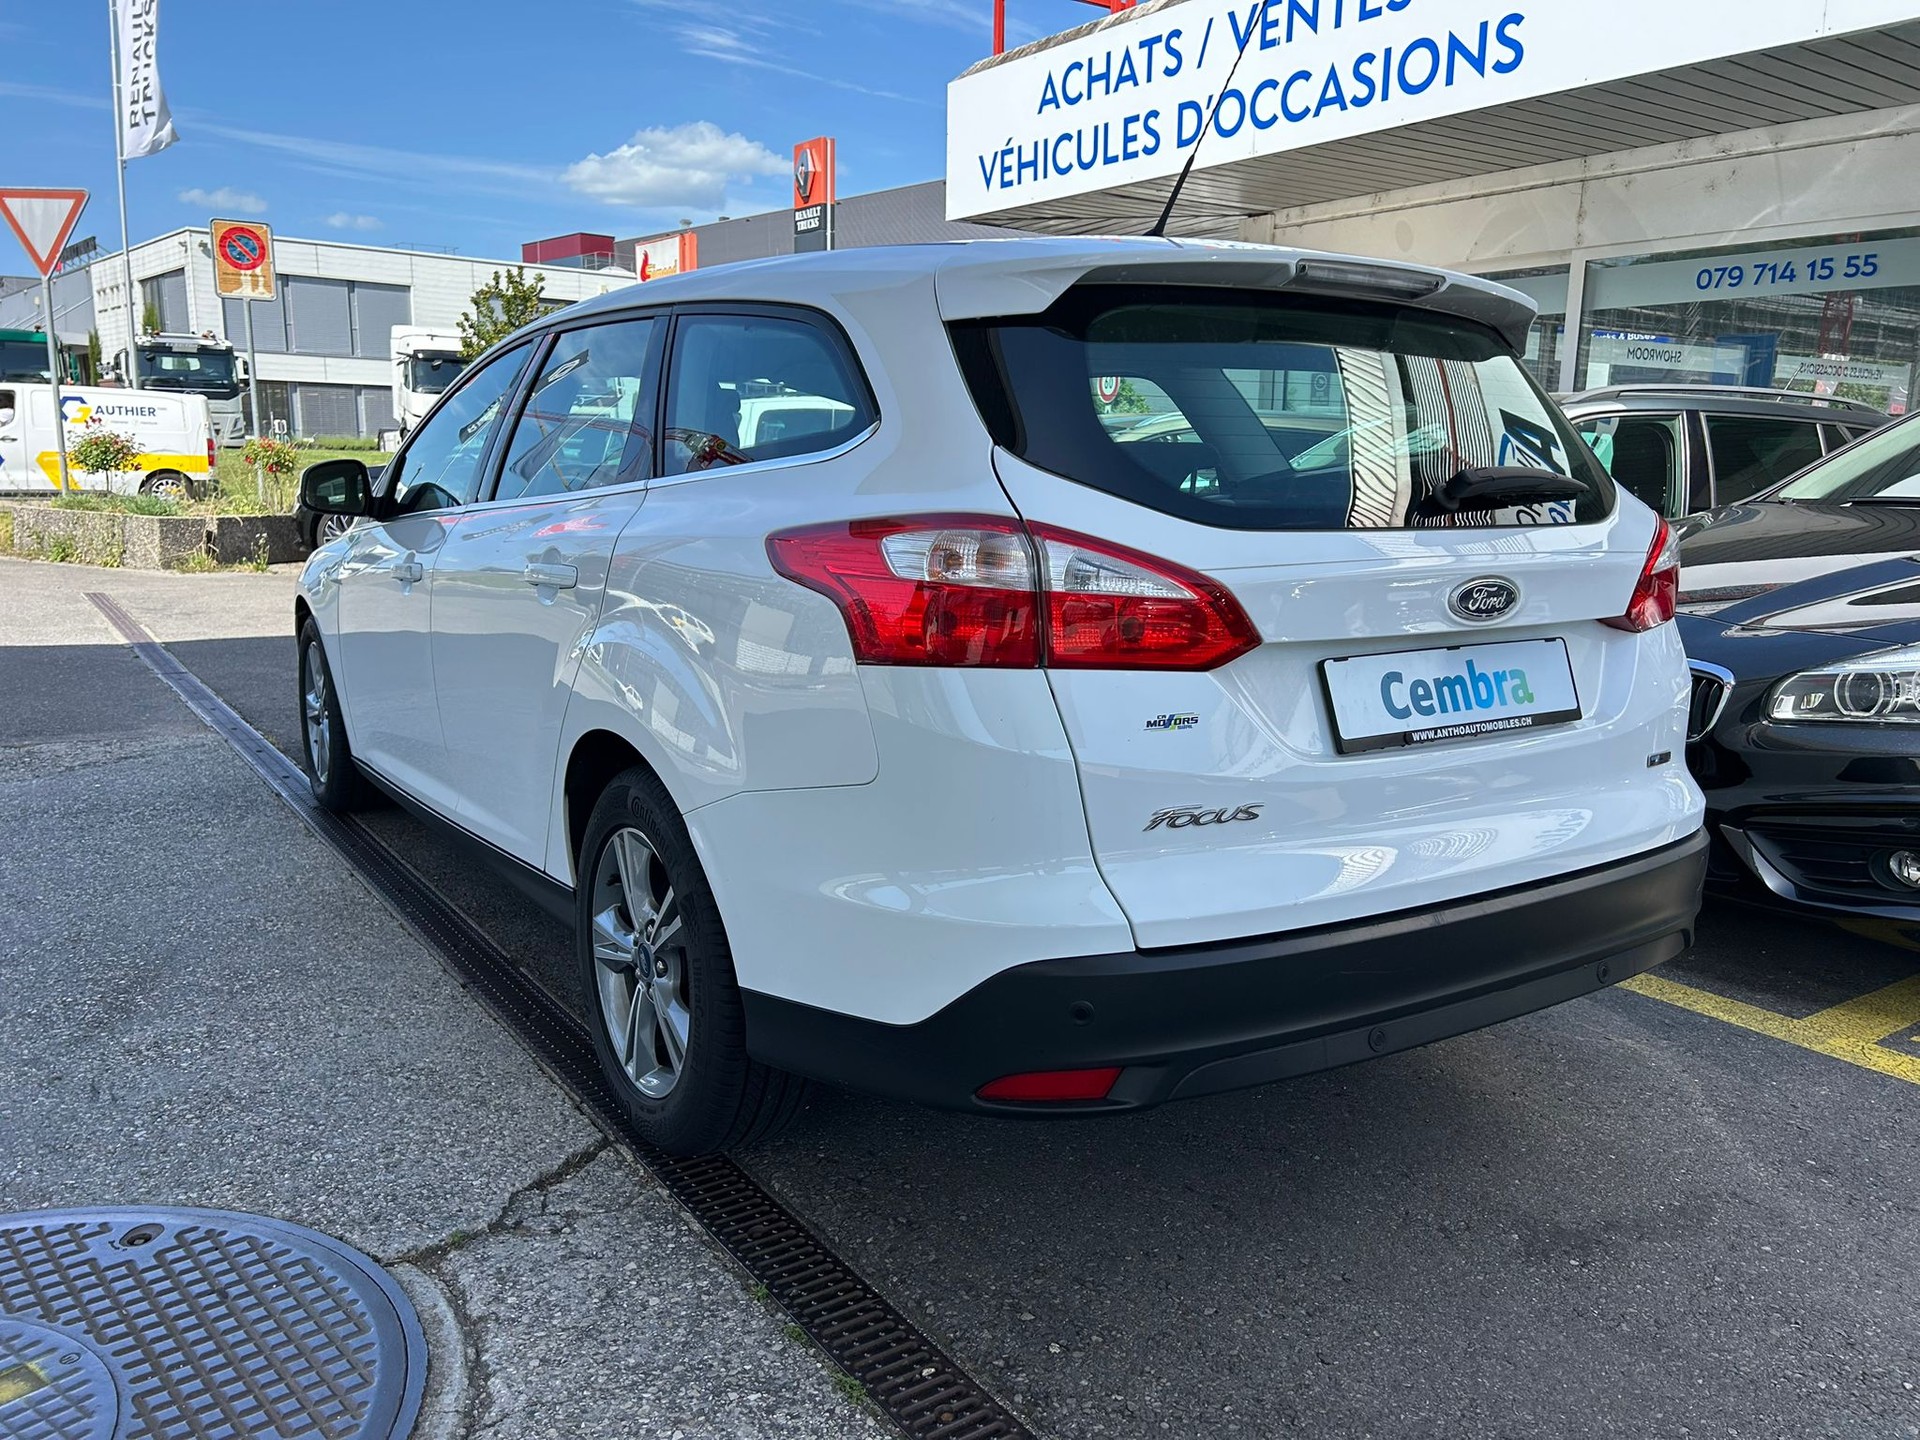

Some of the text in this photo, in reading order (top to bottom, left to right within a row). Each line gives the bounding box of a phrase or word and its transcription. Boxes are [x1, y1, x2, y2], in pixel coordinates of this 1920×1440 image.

[1037, 28, 1183, 115] ACHATS
[1197, 17, 1214, 69] /
[978, 12, 1525, 192] VÉHICULES D'OCCASIONS
[795, 206, 821, 221] RENAULT
[1696, 254, 1878, 290] 079 714 15 55
[95, 405, 156, 417] AUTHIER
[1469, 586, 1507, 611] Ford
[1380, 659, 1535, 720] Cembra
[1412, 716, 1532, 741] WWW.ANTHOAUTOMOBILES.CH
